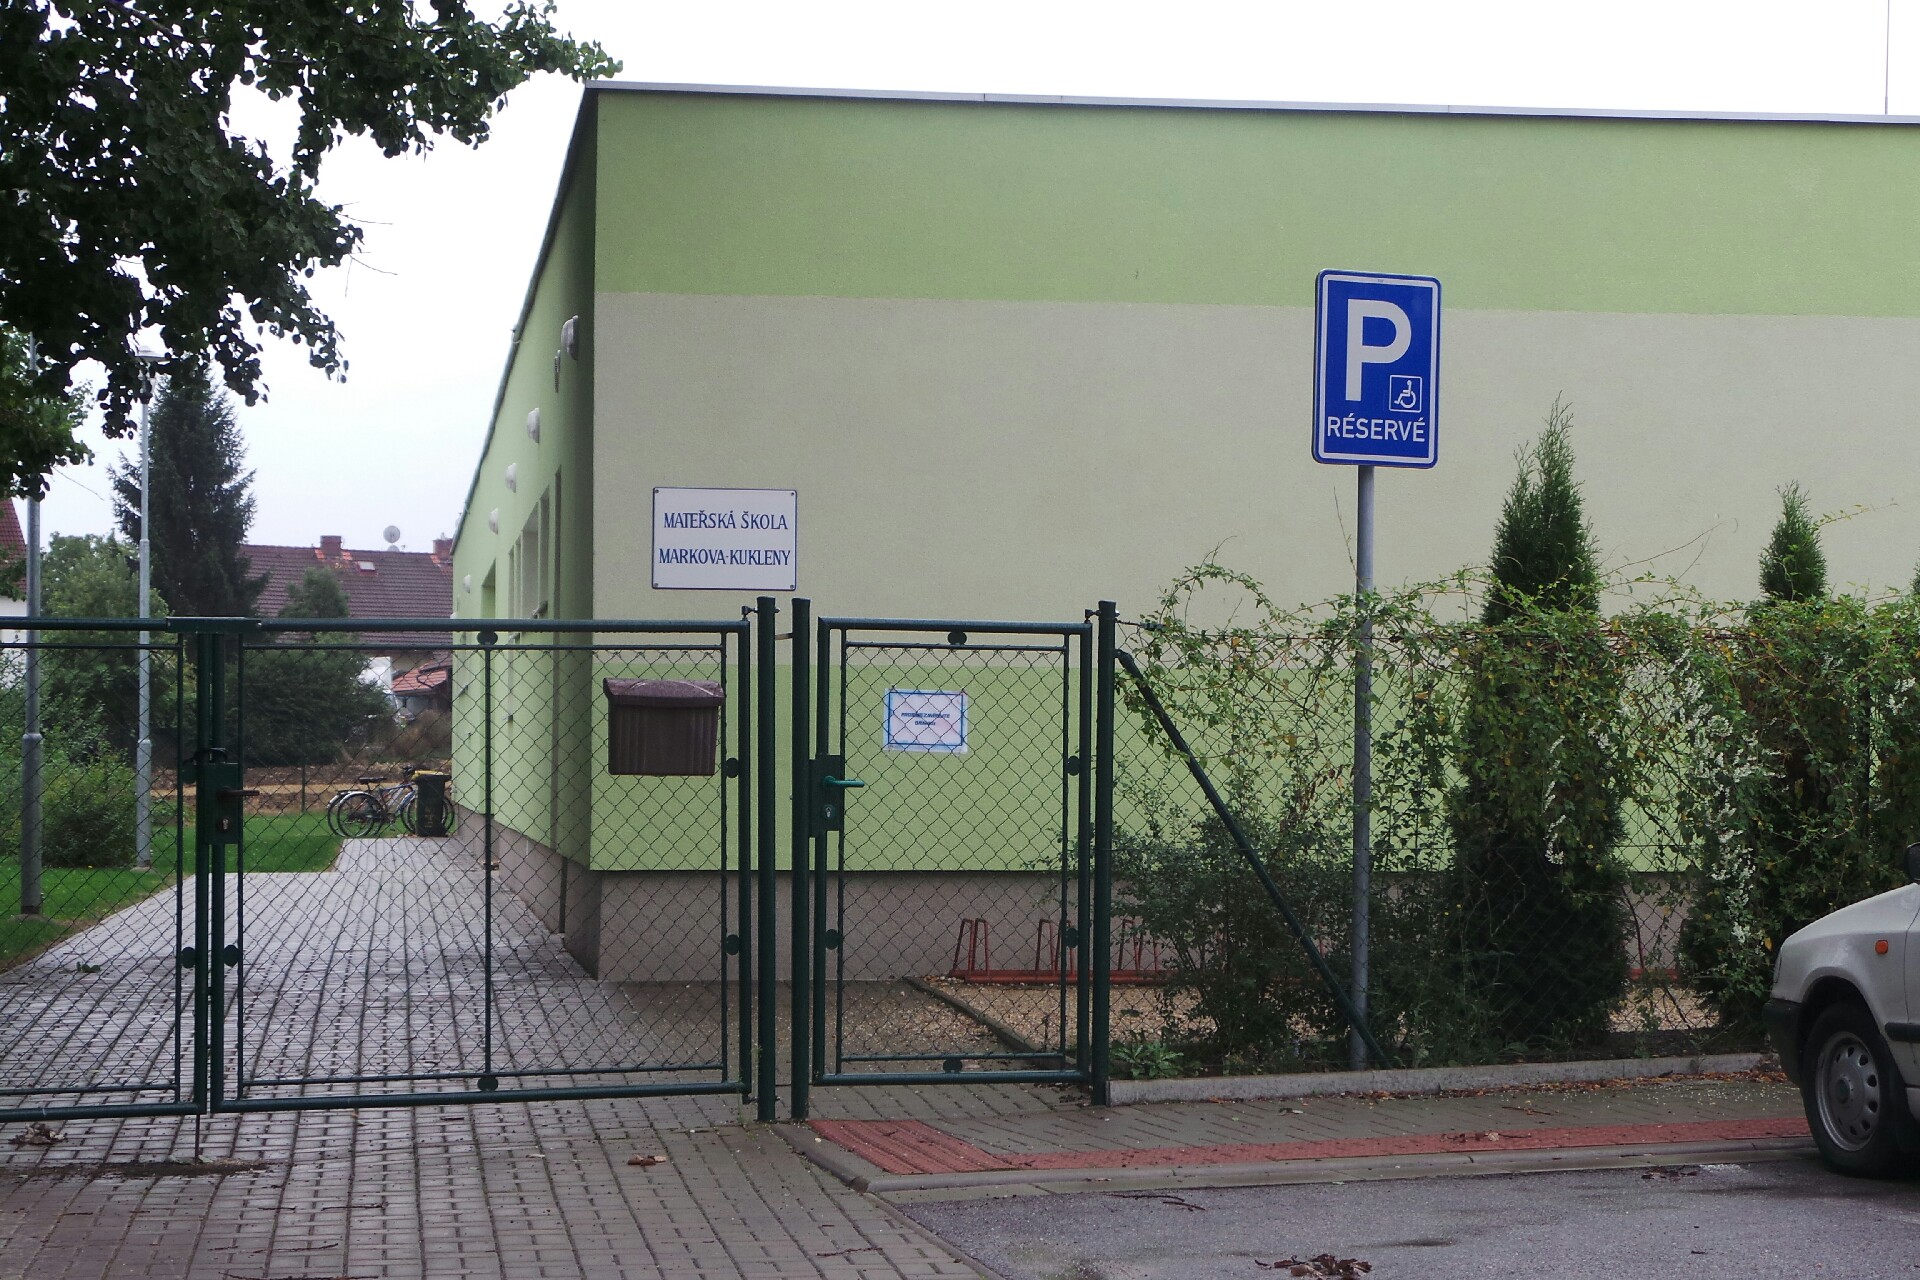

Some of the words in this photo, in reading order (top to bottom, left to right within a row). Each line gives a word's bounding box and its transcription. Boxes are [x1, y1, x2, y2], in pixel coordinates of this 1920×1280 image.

[1345, 298, 1412, 402] P
[1327, 412, 1426, 442] RÉSERVÉ
[663, 510, 737, 529] MATEŘSKÁ
[740, 511, 789, 530] ŠKOLA
